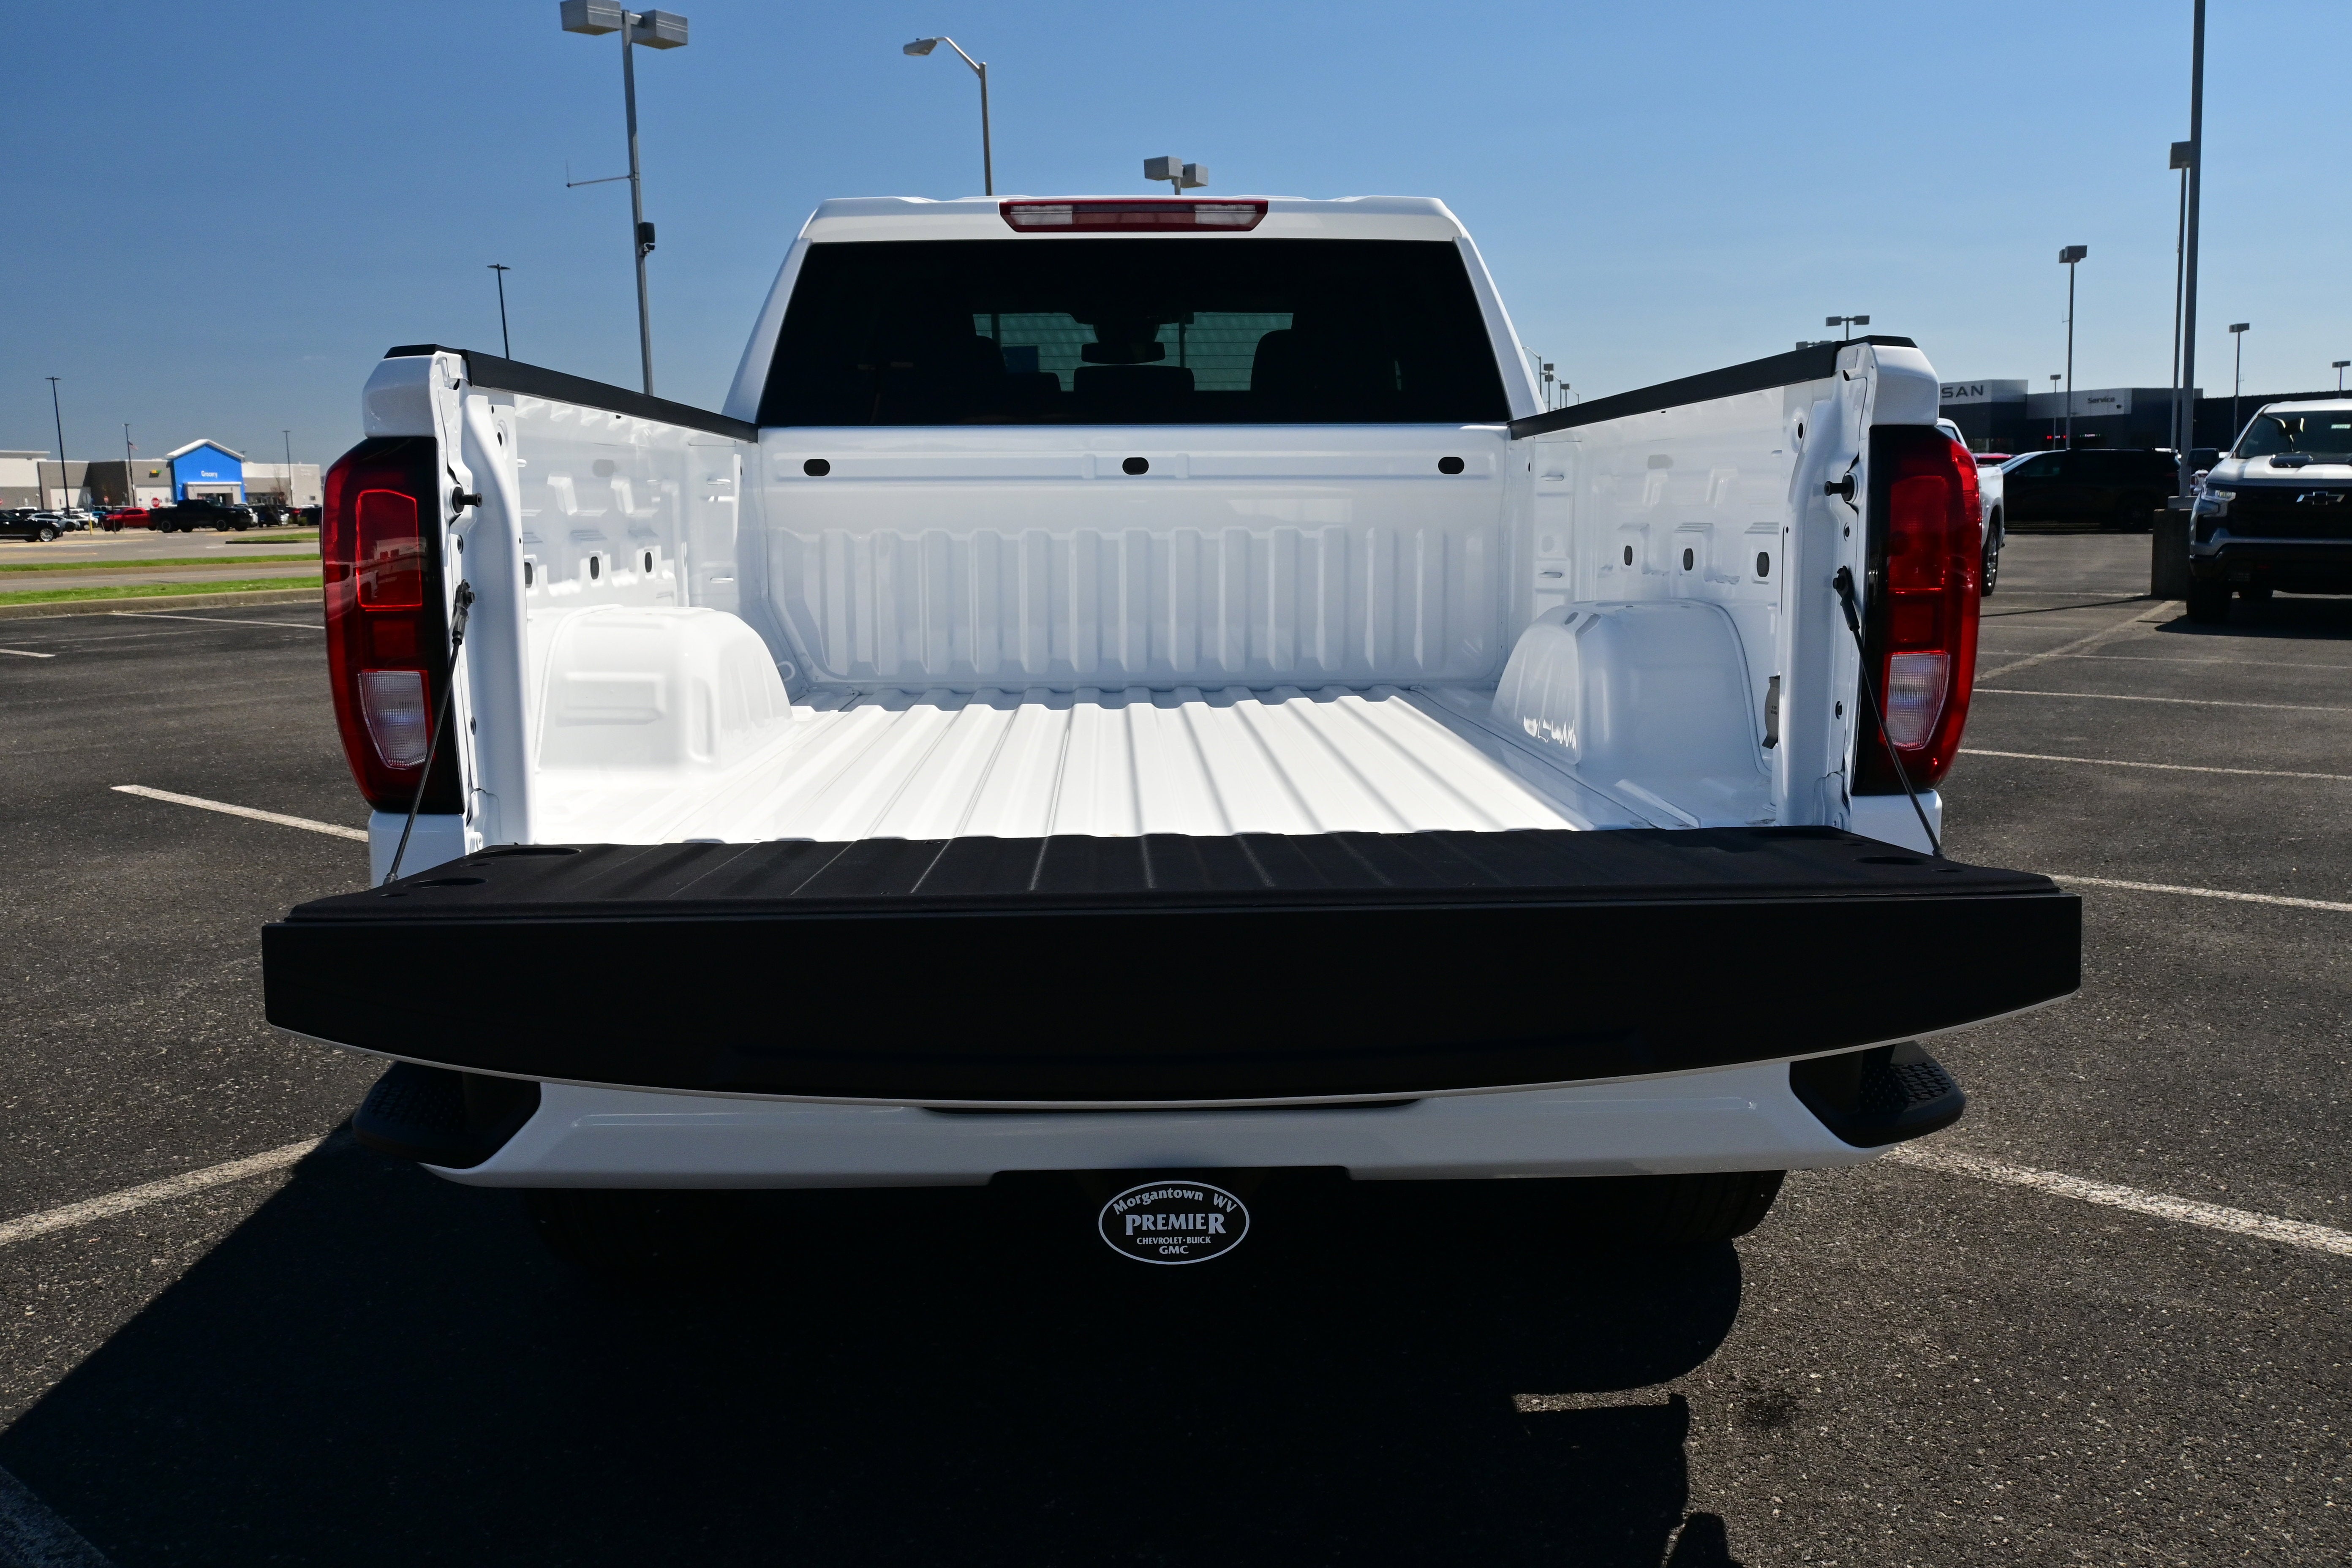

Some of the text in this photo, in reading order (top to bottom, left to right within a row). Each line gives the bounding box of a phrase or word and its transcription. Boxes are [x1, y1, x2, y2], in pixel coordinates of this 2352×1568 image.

[1941, 385, 1984, 398] SAN
[201, 471, 218, 479] Grocery
[1113, 1187, 1237, 1215] Morgantown WV
[1125, 1213, 1227, 1236] PREMIER
[1159, 1245, 1189, 1255] GMC
